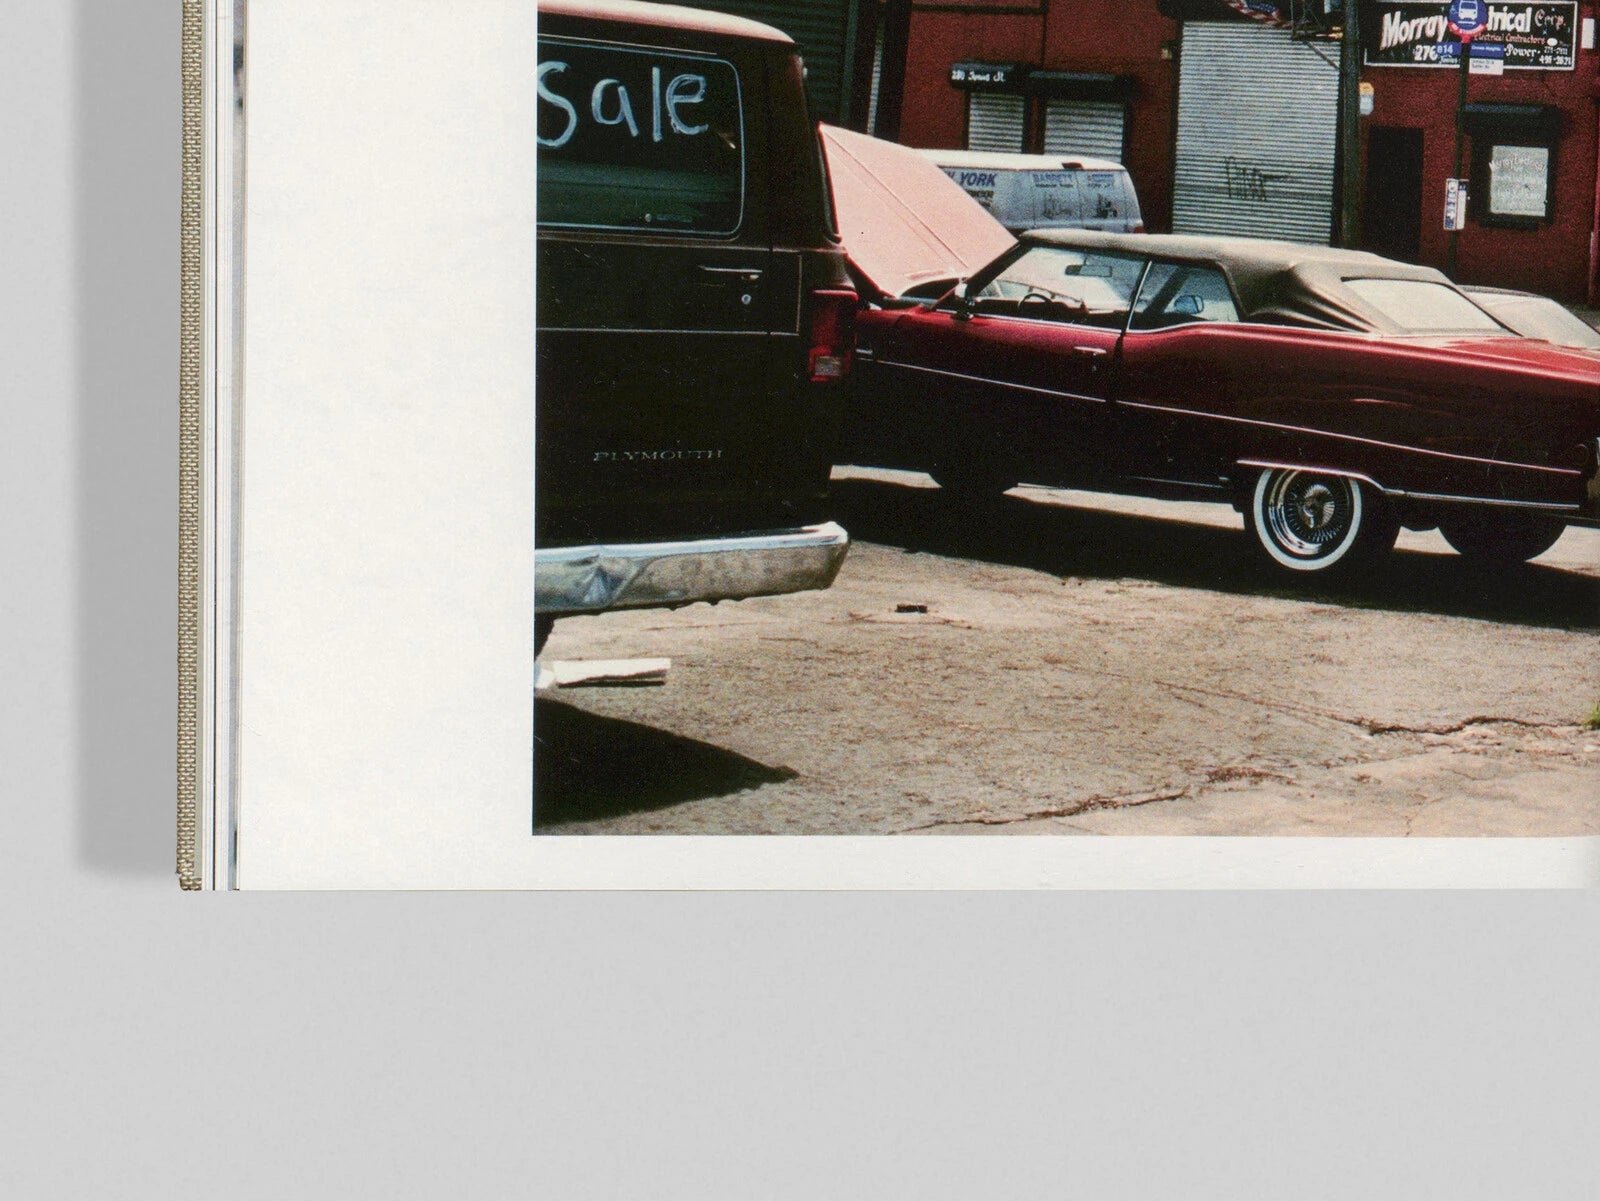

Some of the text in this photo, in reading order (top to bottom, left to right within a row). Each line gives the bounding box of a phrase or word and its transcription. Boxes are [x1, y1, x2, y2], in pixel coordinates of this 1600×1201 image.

[537, 61, 709, 147] Sale
[959, 172, 998, 188] YORK
[592, 449, 723, 462] PLYMOUTH
